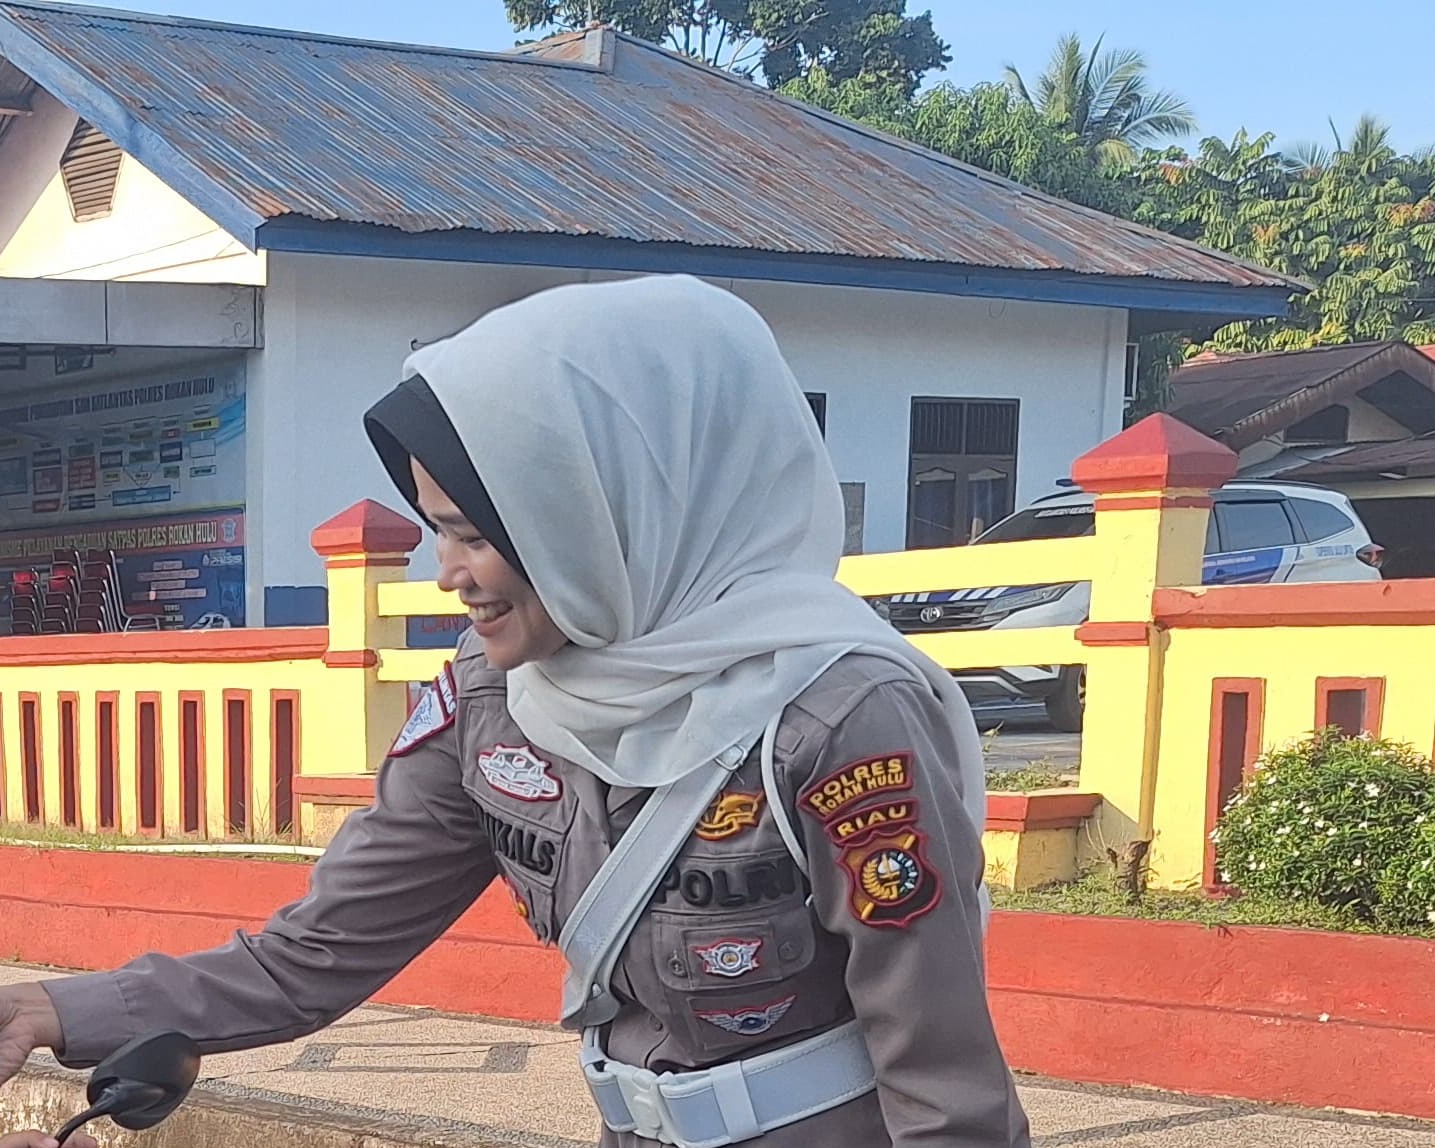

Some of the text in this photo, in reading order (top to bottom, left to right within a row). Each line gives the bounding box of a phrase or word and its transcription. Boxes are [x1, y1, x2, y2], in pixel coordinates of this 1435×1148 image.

[107, 527, 137, 550] SATPAS
[137, 525, 167, 548] POLRES
[168, 523, 194, 545] ROKAN
[195, 521, 217, 543] HULU
[809, 758, 903, 807] POLRES
[837, 805, 907, 837] RIAU
